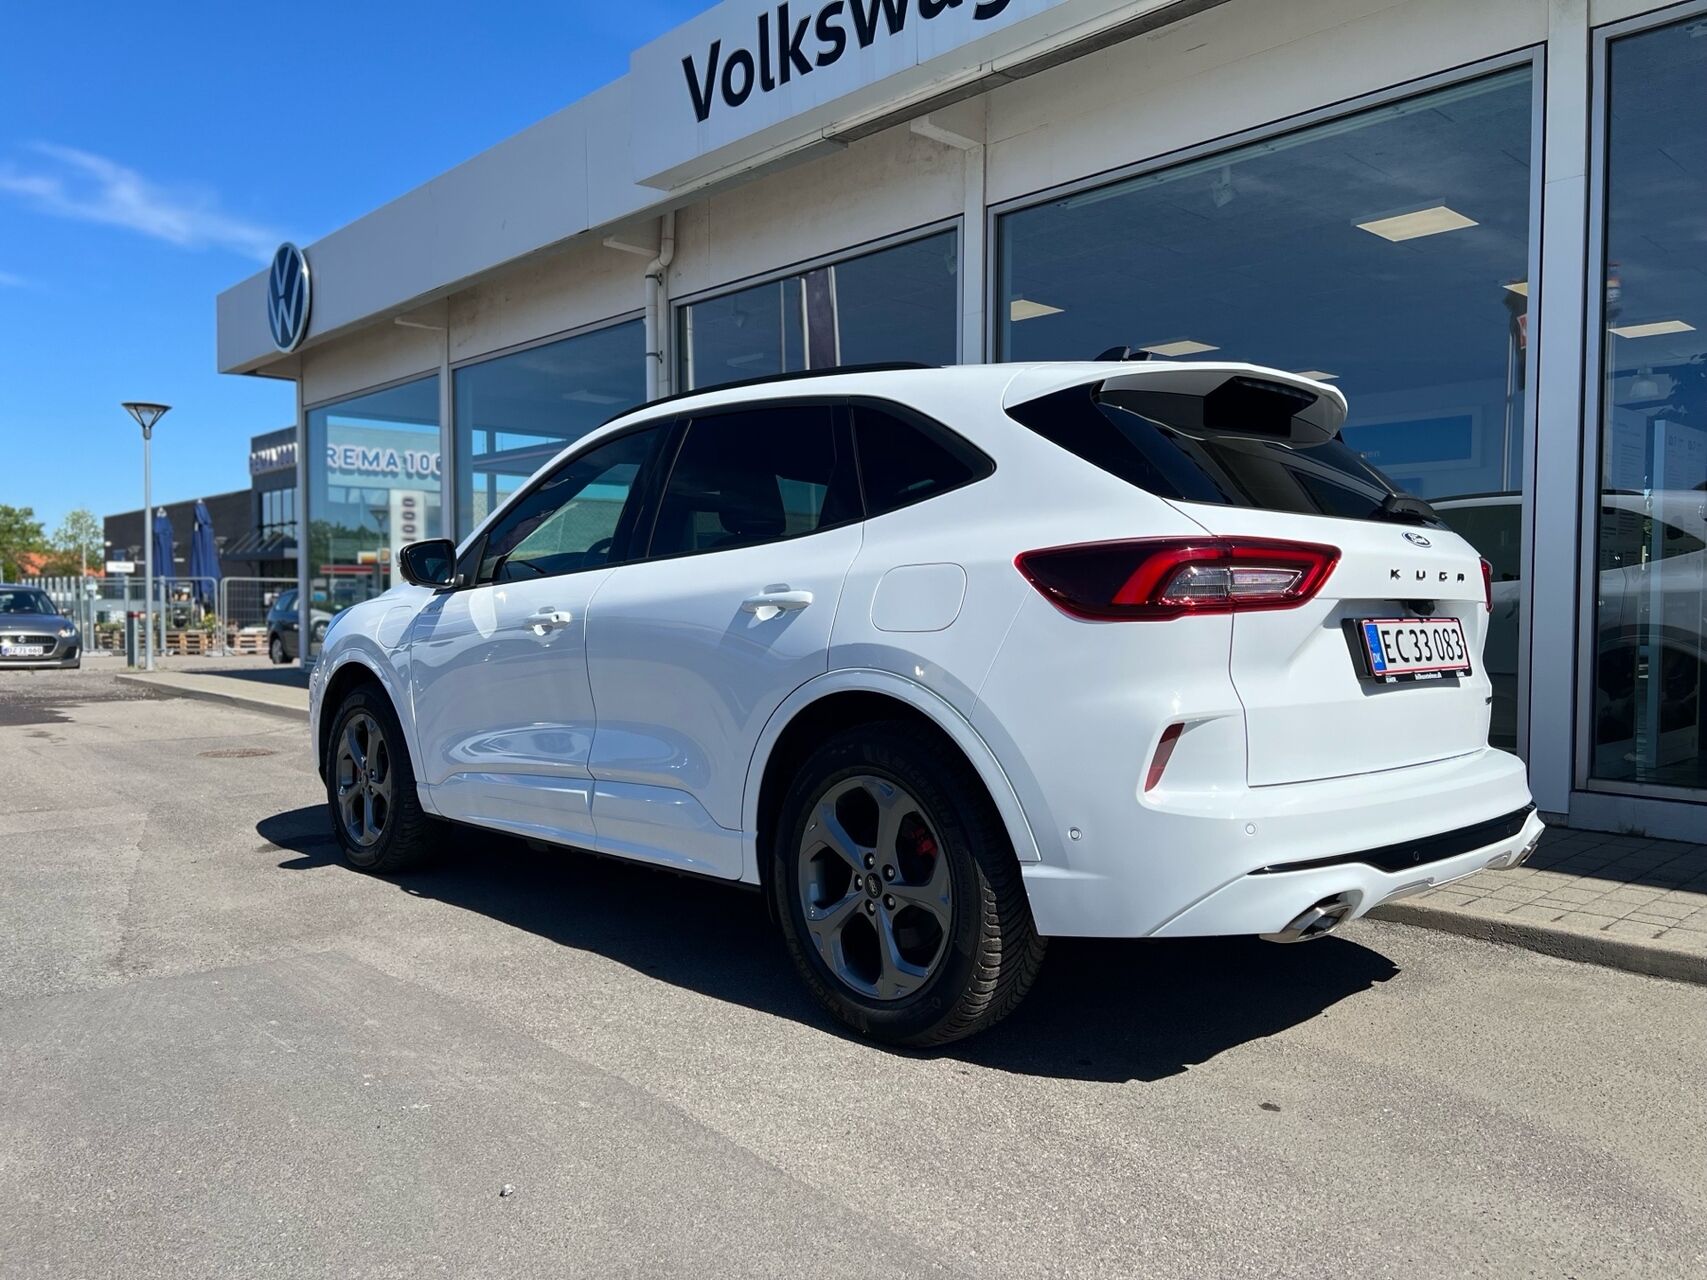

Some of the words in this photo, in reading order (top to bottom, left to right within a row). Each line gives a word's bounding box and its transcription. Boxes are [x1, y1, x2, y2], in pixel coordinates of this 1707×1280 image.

[682, 0, 1011, 123] Volksw
[327, 445, 400, 471] REMA
[1390, 569, 1465, 582] KUGA
[1381, 629, 1410, 663] EC
[1409, 629, 1433, 662] 33
[1433, 628, 1464, 661] 083
